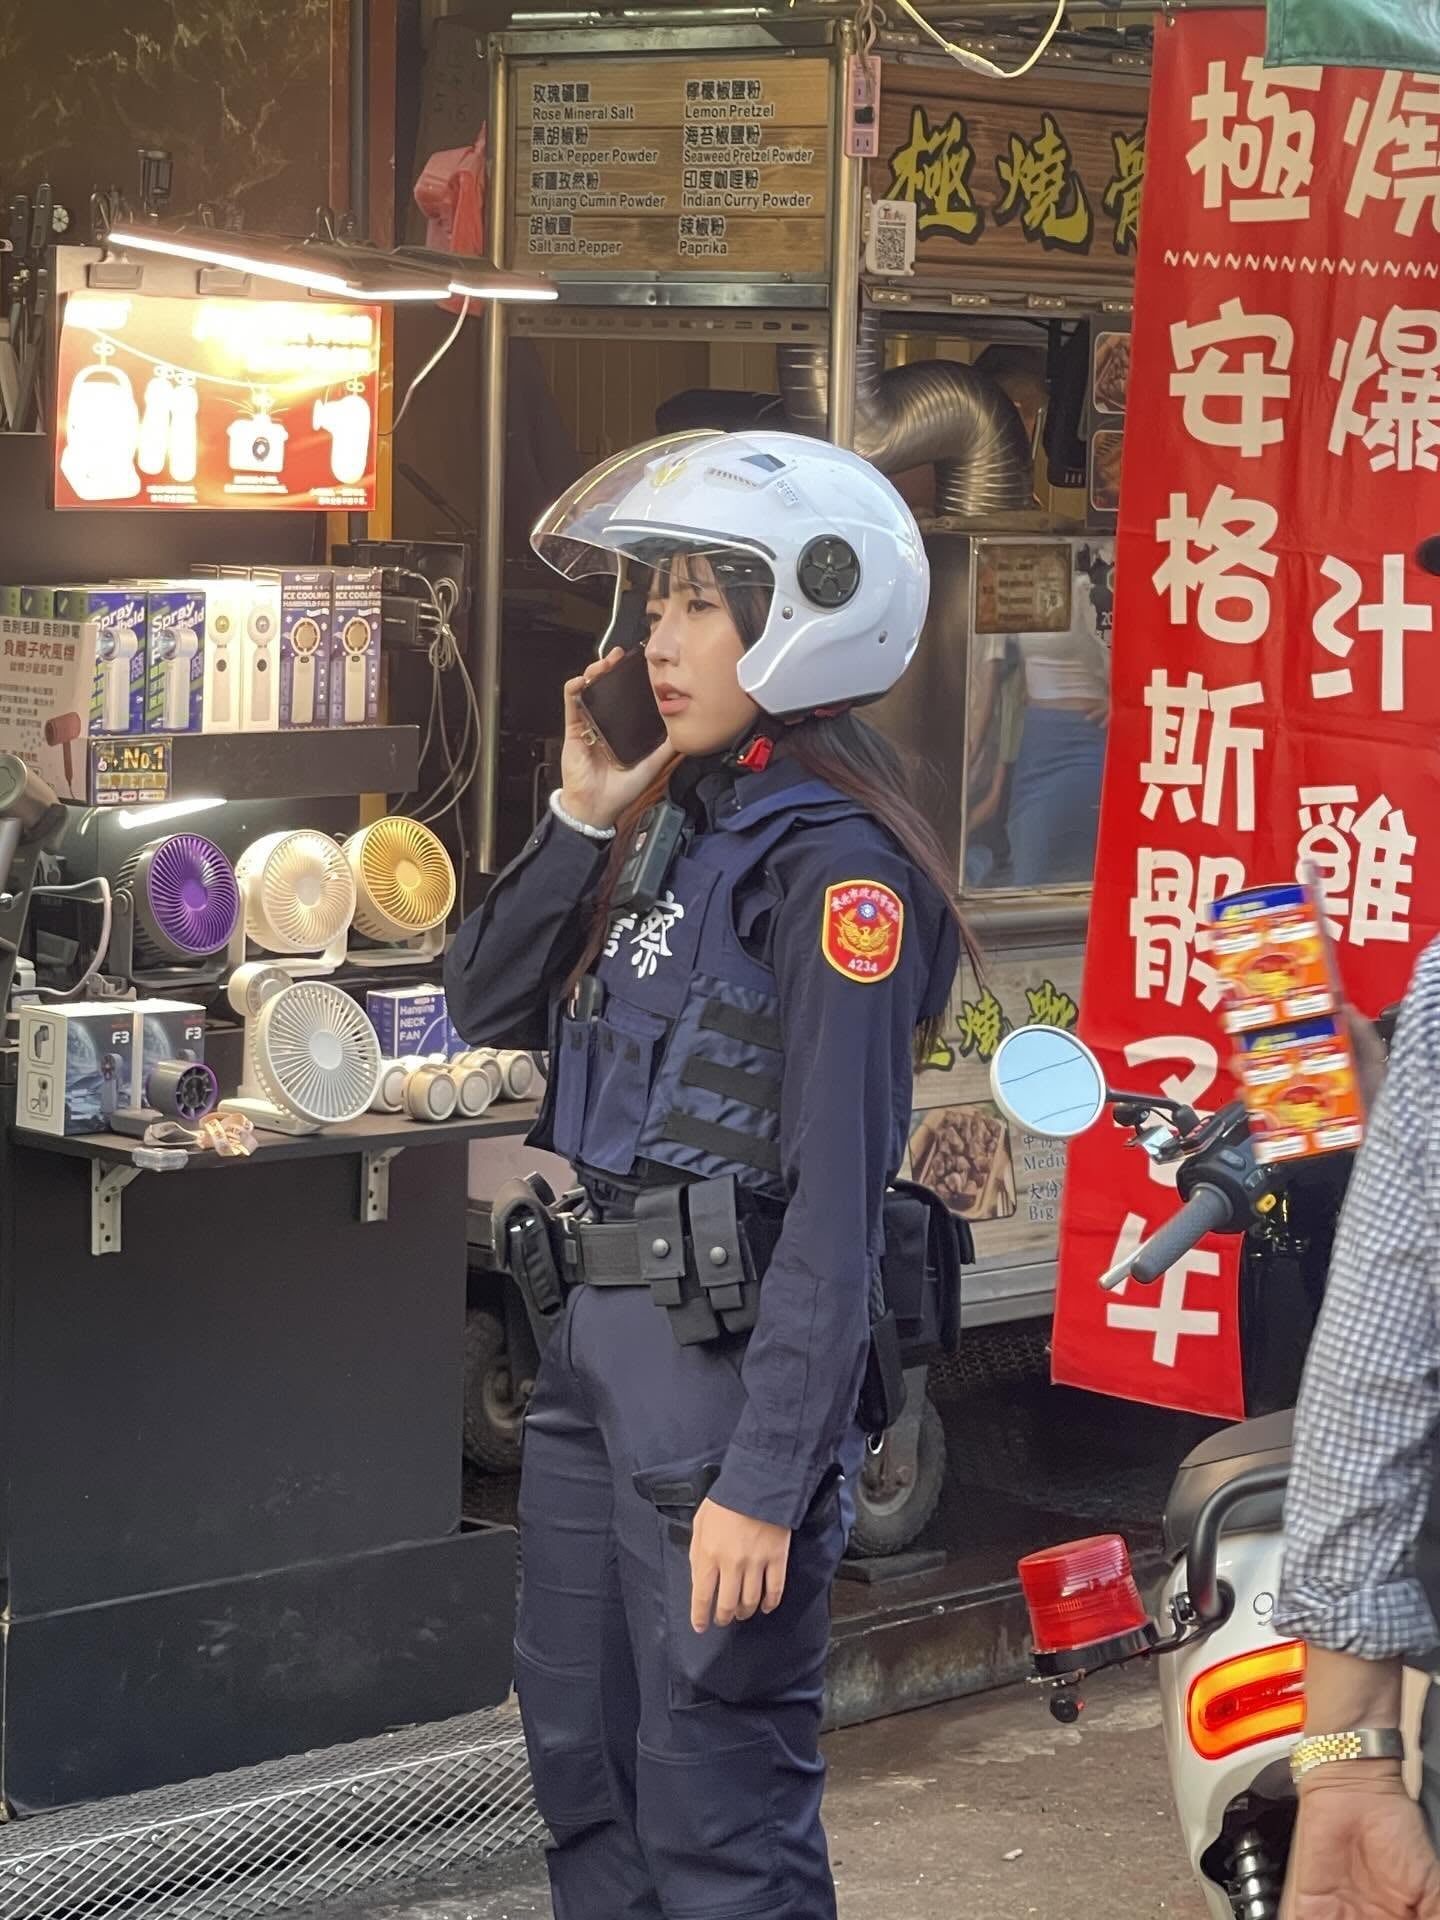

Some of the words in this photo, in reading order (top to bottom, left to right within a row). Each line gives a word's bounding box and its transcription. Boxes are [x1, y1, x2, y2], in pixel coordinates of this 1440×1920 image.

[532, 107, 561, 120] Rose
[564, 105, 608, 120] Mineral
[610, 106, 634, 119] Salt
[685, 105, 726, 118] Lemon
[729, 103, 774, 118] Pretzel
[533, 126, 587, 145] 黑胡椒粉
[685, 125, 760, 145] 海苔椒鹽粉
[532, 149, 564, 163] Black
[567, 149, 609, 165] Pepper
[612, 149, 658, 163] Powder
[684, 149, 731, 163] Seaweed
[733, 148, 770, 165] Pretzel
[772, 148, 813, 163] Powder
[683, 169, 759, 190] 印度咖哩粉
[531, 194, 577, 210] Xinjiang
[579, 194, 617, 208] Cumin
[619, 194, 665, 208] Powder
[683, 193, 722, 207] Indian
[724, 193, 760, 209] Curry
[763, 193, 812, 207] Powder
[530, 216, 572, 235] 胡椒鹽
[680, 216, 725, 236] 辣椒粉
[529, 239, 551, 253] Salt
[554, 239, 576, 253] and
[578, 239, 622, 255] Pepper
[679, 240, 728, 256] Paprika
[152, 601, 195, 633] Spray
[847, 958, 878, 974] 4234
[400, 1016, 427, 1028] NECK
[111, 1030, 130, 1045] F3
[185, 1026, 203, 1041] F3
[400, 1029, 421, 1041] FAN
[1029, 1205, 1054, 1222] Big
